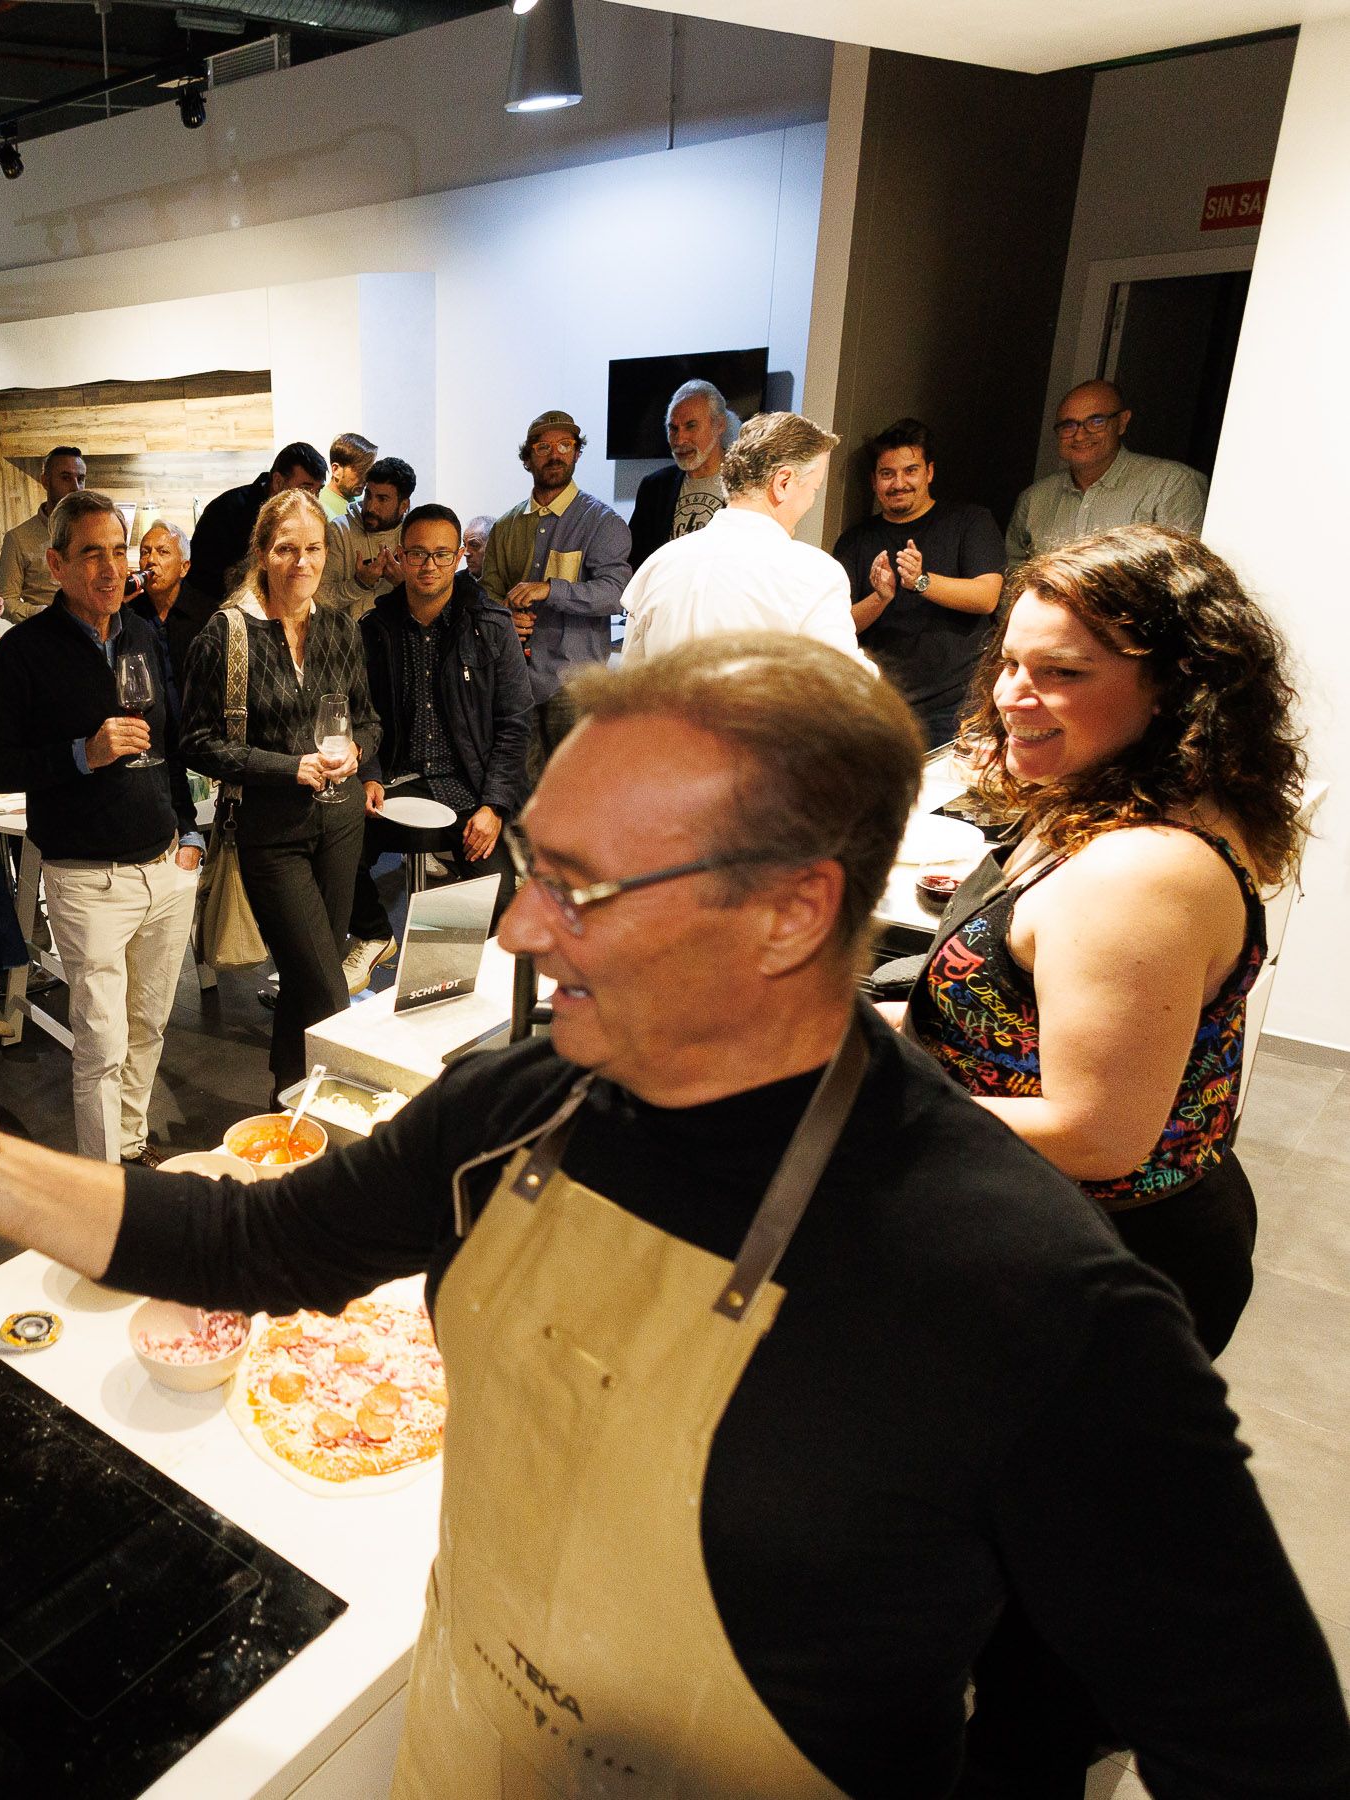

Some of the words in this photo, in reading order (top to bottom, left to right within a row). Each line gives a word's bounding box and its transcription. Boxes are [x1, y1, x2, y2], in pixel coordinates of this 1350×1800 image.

[1205, 194, 1236, 221] SIN
[1238, 191, 1266, 216] SA
[409, 978, 462, 1000] SCHMIDT
[507, 1640, 584, 1724] TEKA
